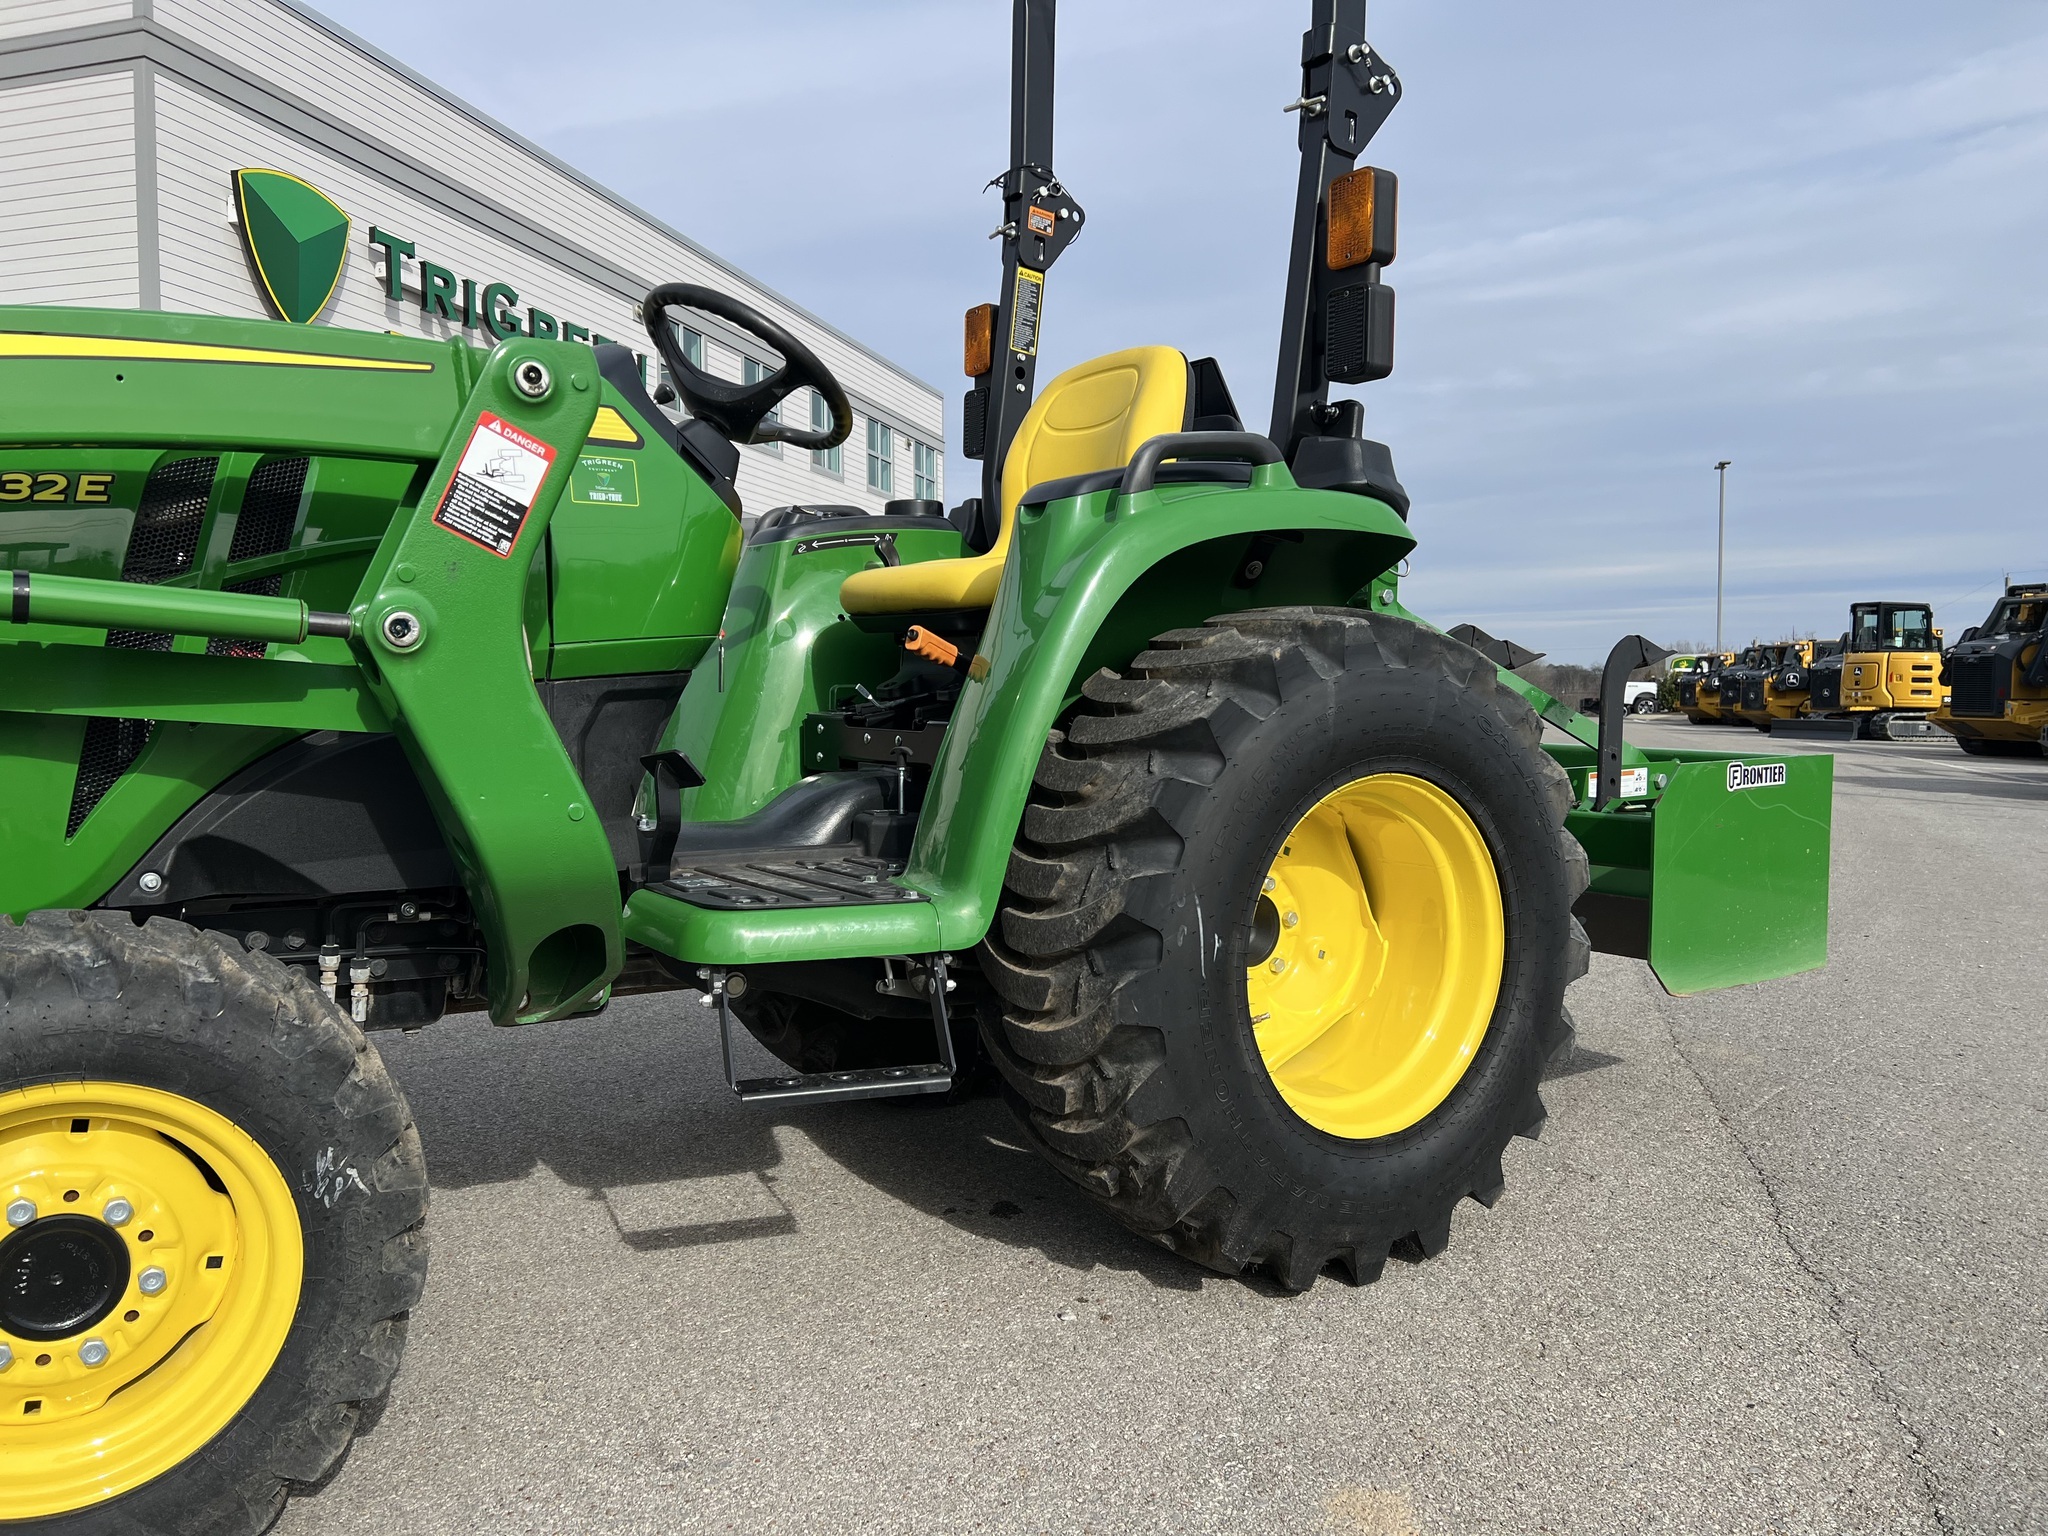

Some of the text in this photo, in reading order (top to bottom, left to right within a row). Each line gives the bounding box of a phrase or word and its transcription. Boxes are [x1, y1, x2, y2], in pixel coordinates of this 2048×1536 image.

[1024, 272, 1042, 282] CAUTION
[503, 428, 546, 456] DANGER
[1729, 764, 1784, 788] FRONTIER
